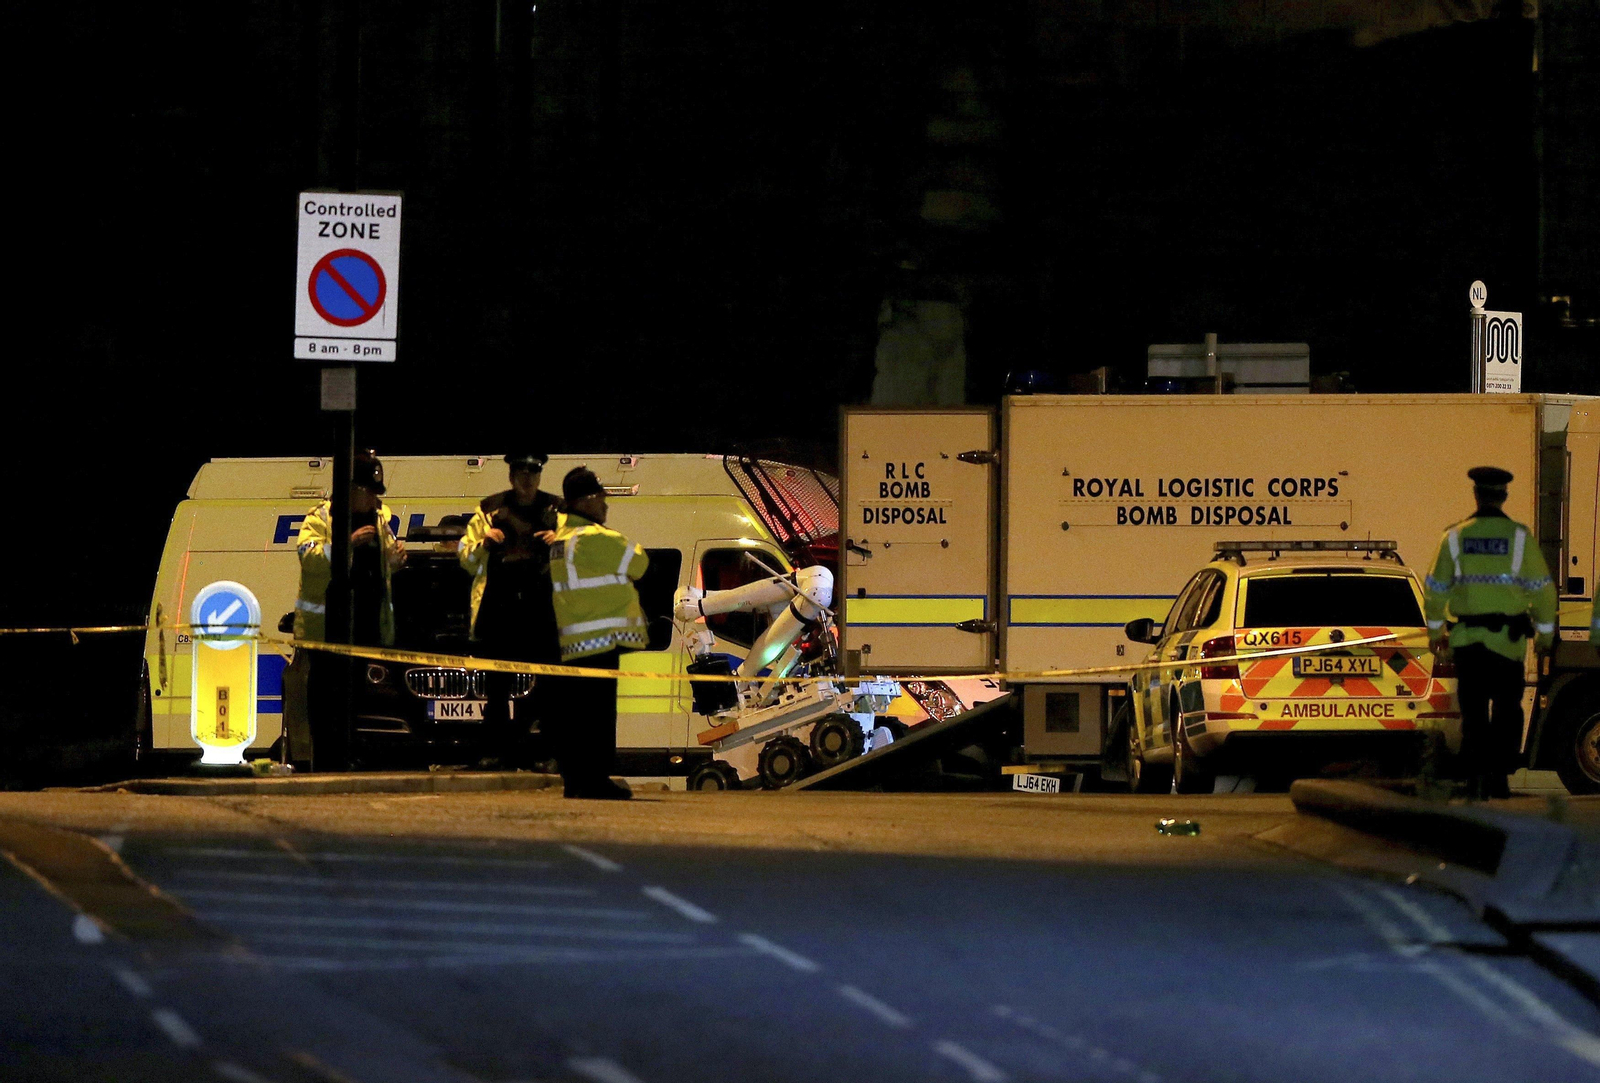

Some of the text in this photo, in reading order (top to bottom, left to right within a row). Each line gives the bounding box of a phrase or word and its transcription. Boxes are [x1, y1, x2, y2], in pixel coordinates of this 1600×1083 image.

[305, 201, 397, 218] Controlled
[318, 221, 380, 240] ZONE
[1472, 287, 1485, 300] NL
[879, 481, 931, 498] BOMB
[1073, 477, 1339, 497] ROYAL LOGISTIC CORPS
[863, 507, 947, 524] DISPOSAL
[1117, 506, 1292, 526] BOMB DISPOSAL
[1244, 630, 1302, 646] QX615
[1303, 658, 1378, 673] PJ64 XYL
[440, 703, 474, 717] NK14
[1281, 703, 1395, 718] AMBULANCE
[1017, 774, 1056, 793] LJ64 EKH
